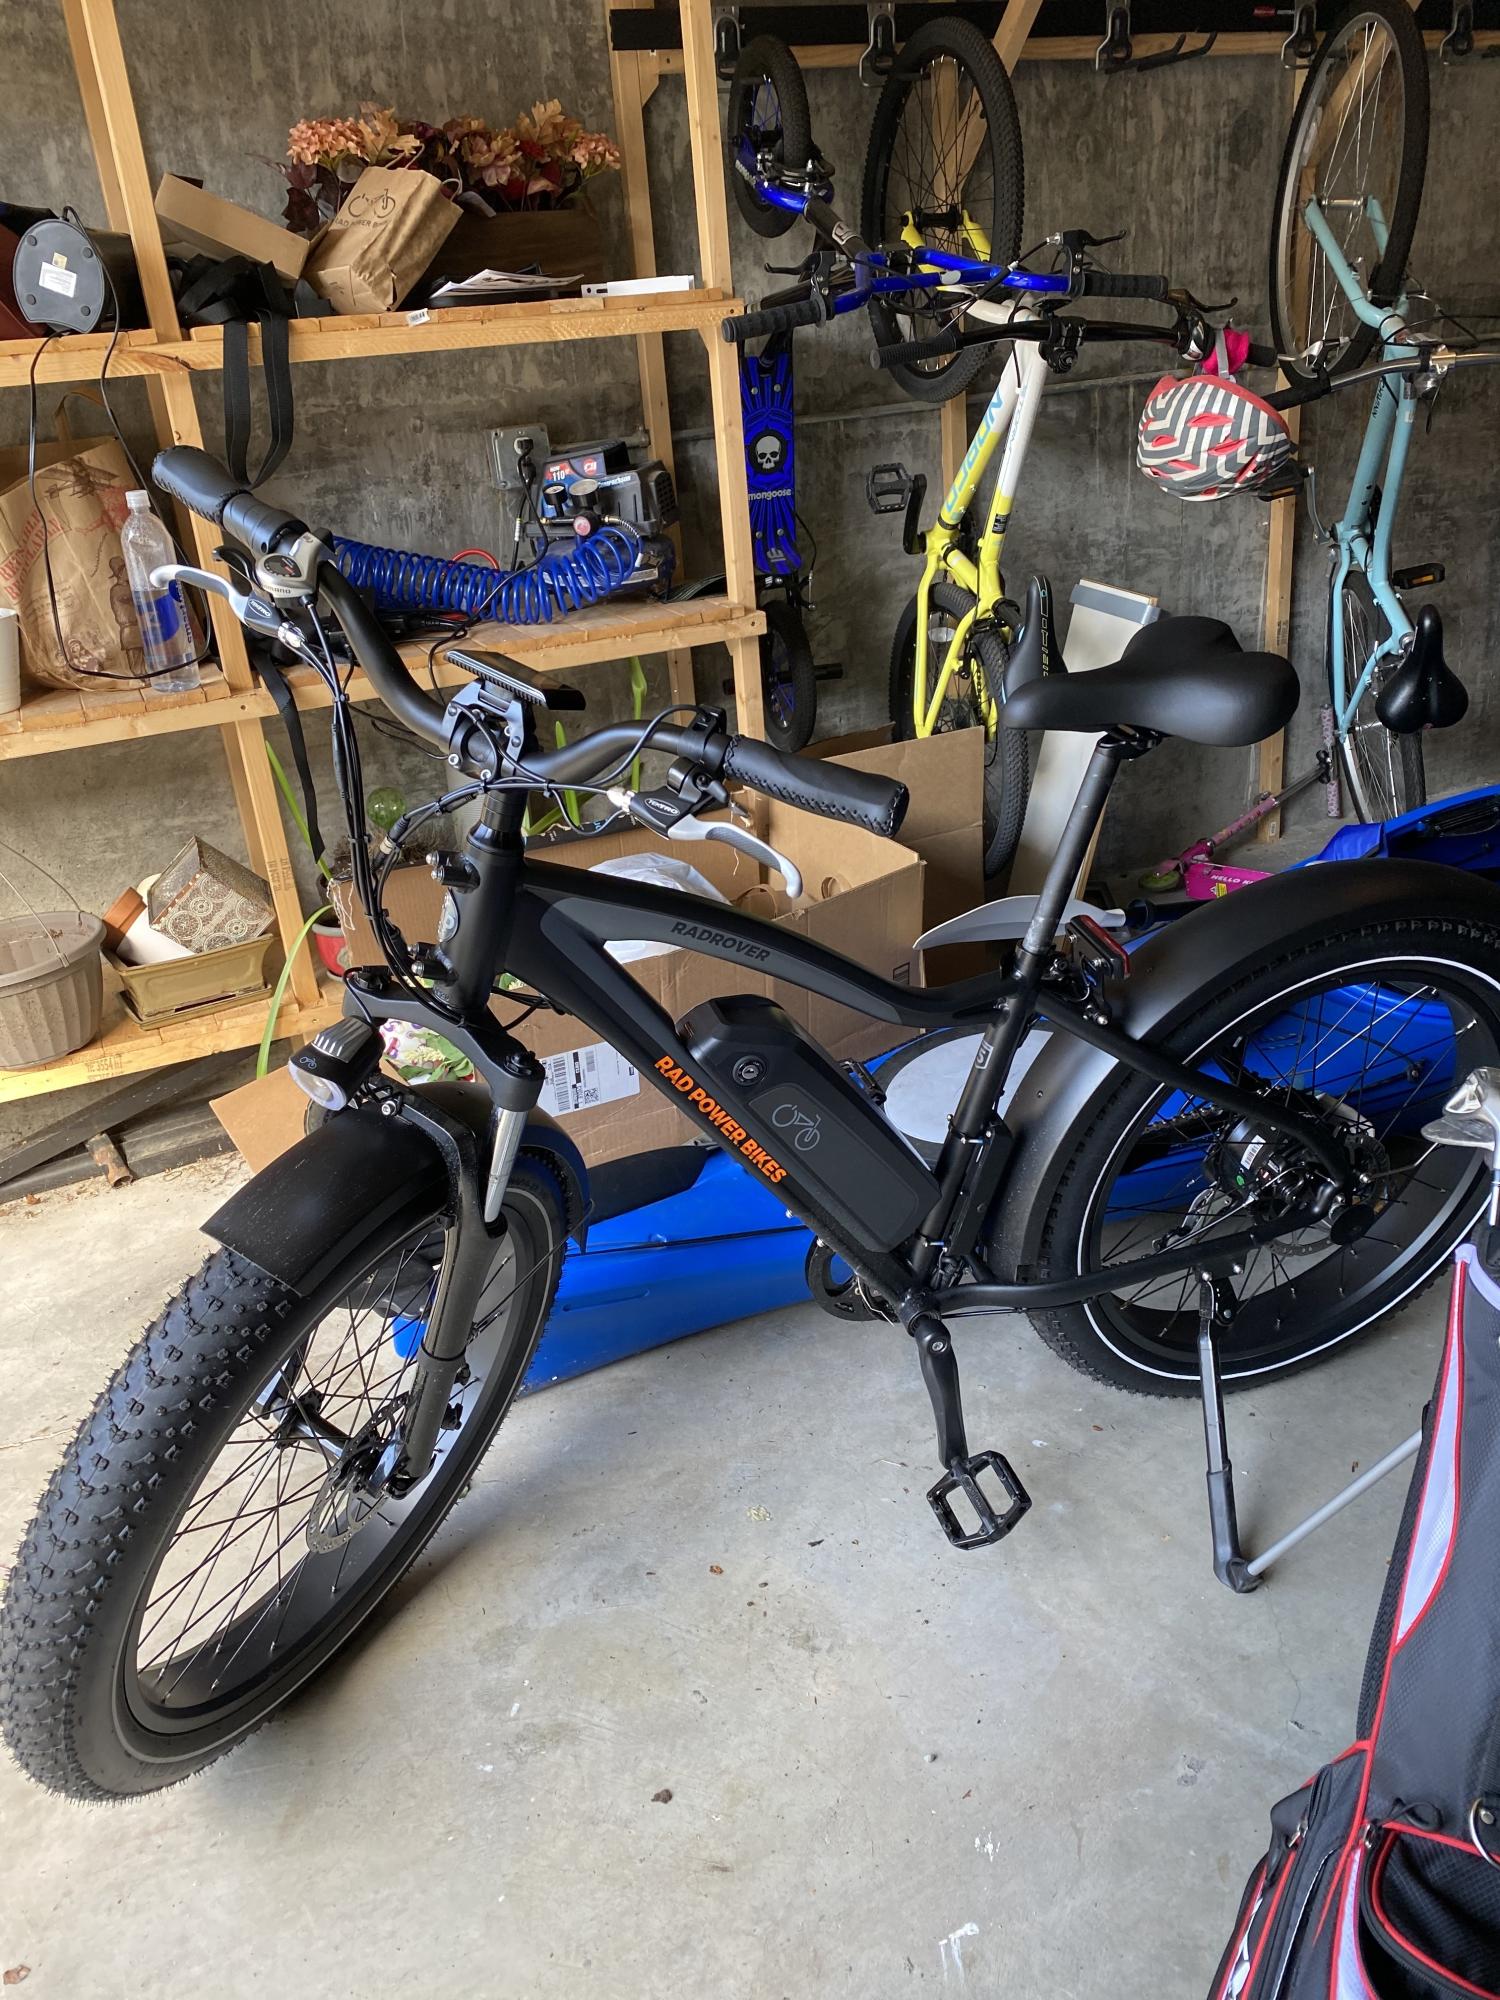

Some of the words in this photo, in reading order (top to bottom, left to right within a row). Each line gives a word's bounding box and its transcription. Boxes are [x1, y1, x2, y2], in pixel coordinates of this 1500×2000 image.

[552, 470, 565, 482] 110
[749, 488, 792, 500] mongoose
[648, 799, 679, 815] TEKTRO
[1210, 874, 1241, 884] HELLO
[670, 921, 771, 961] RADROVER
[654, 1055, 694, 1092] RAD
[688, 1087, 747, 1147] POWER
[740, 1138, 787, 1183] BIKES
